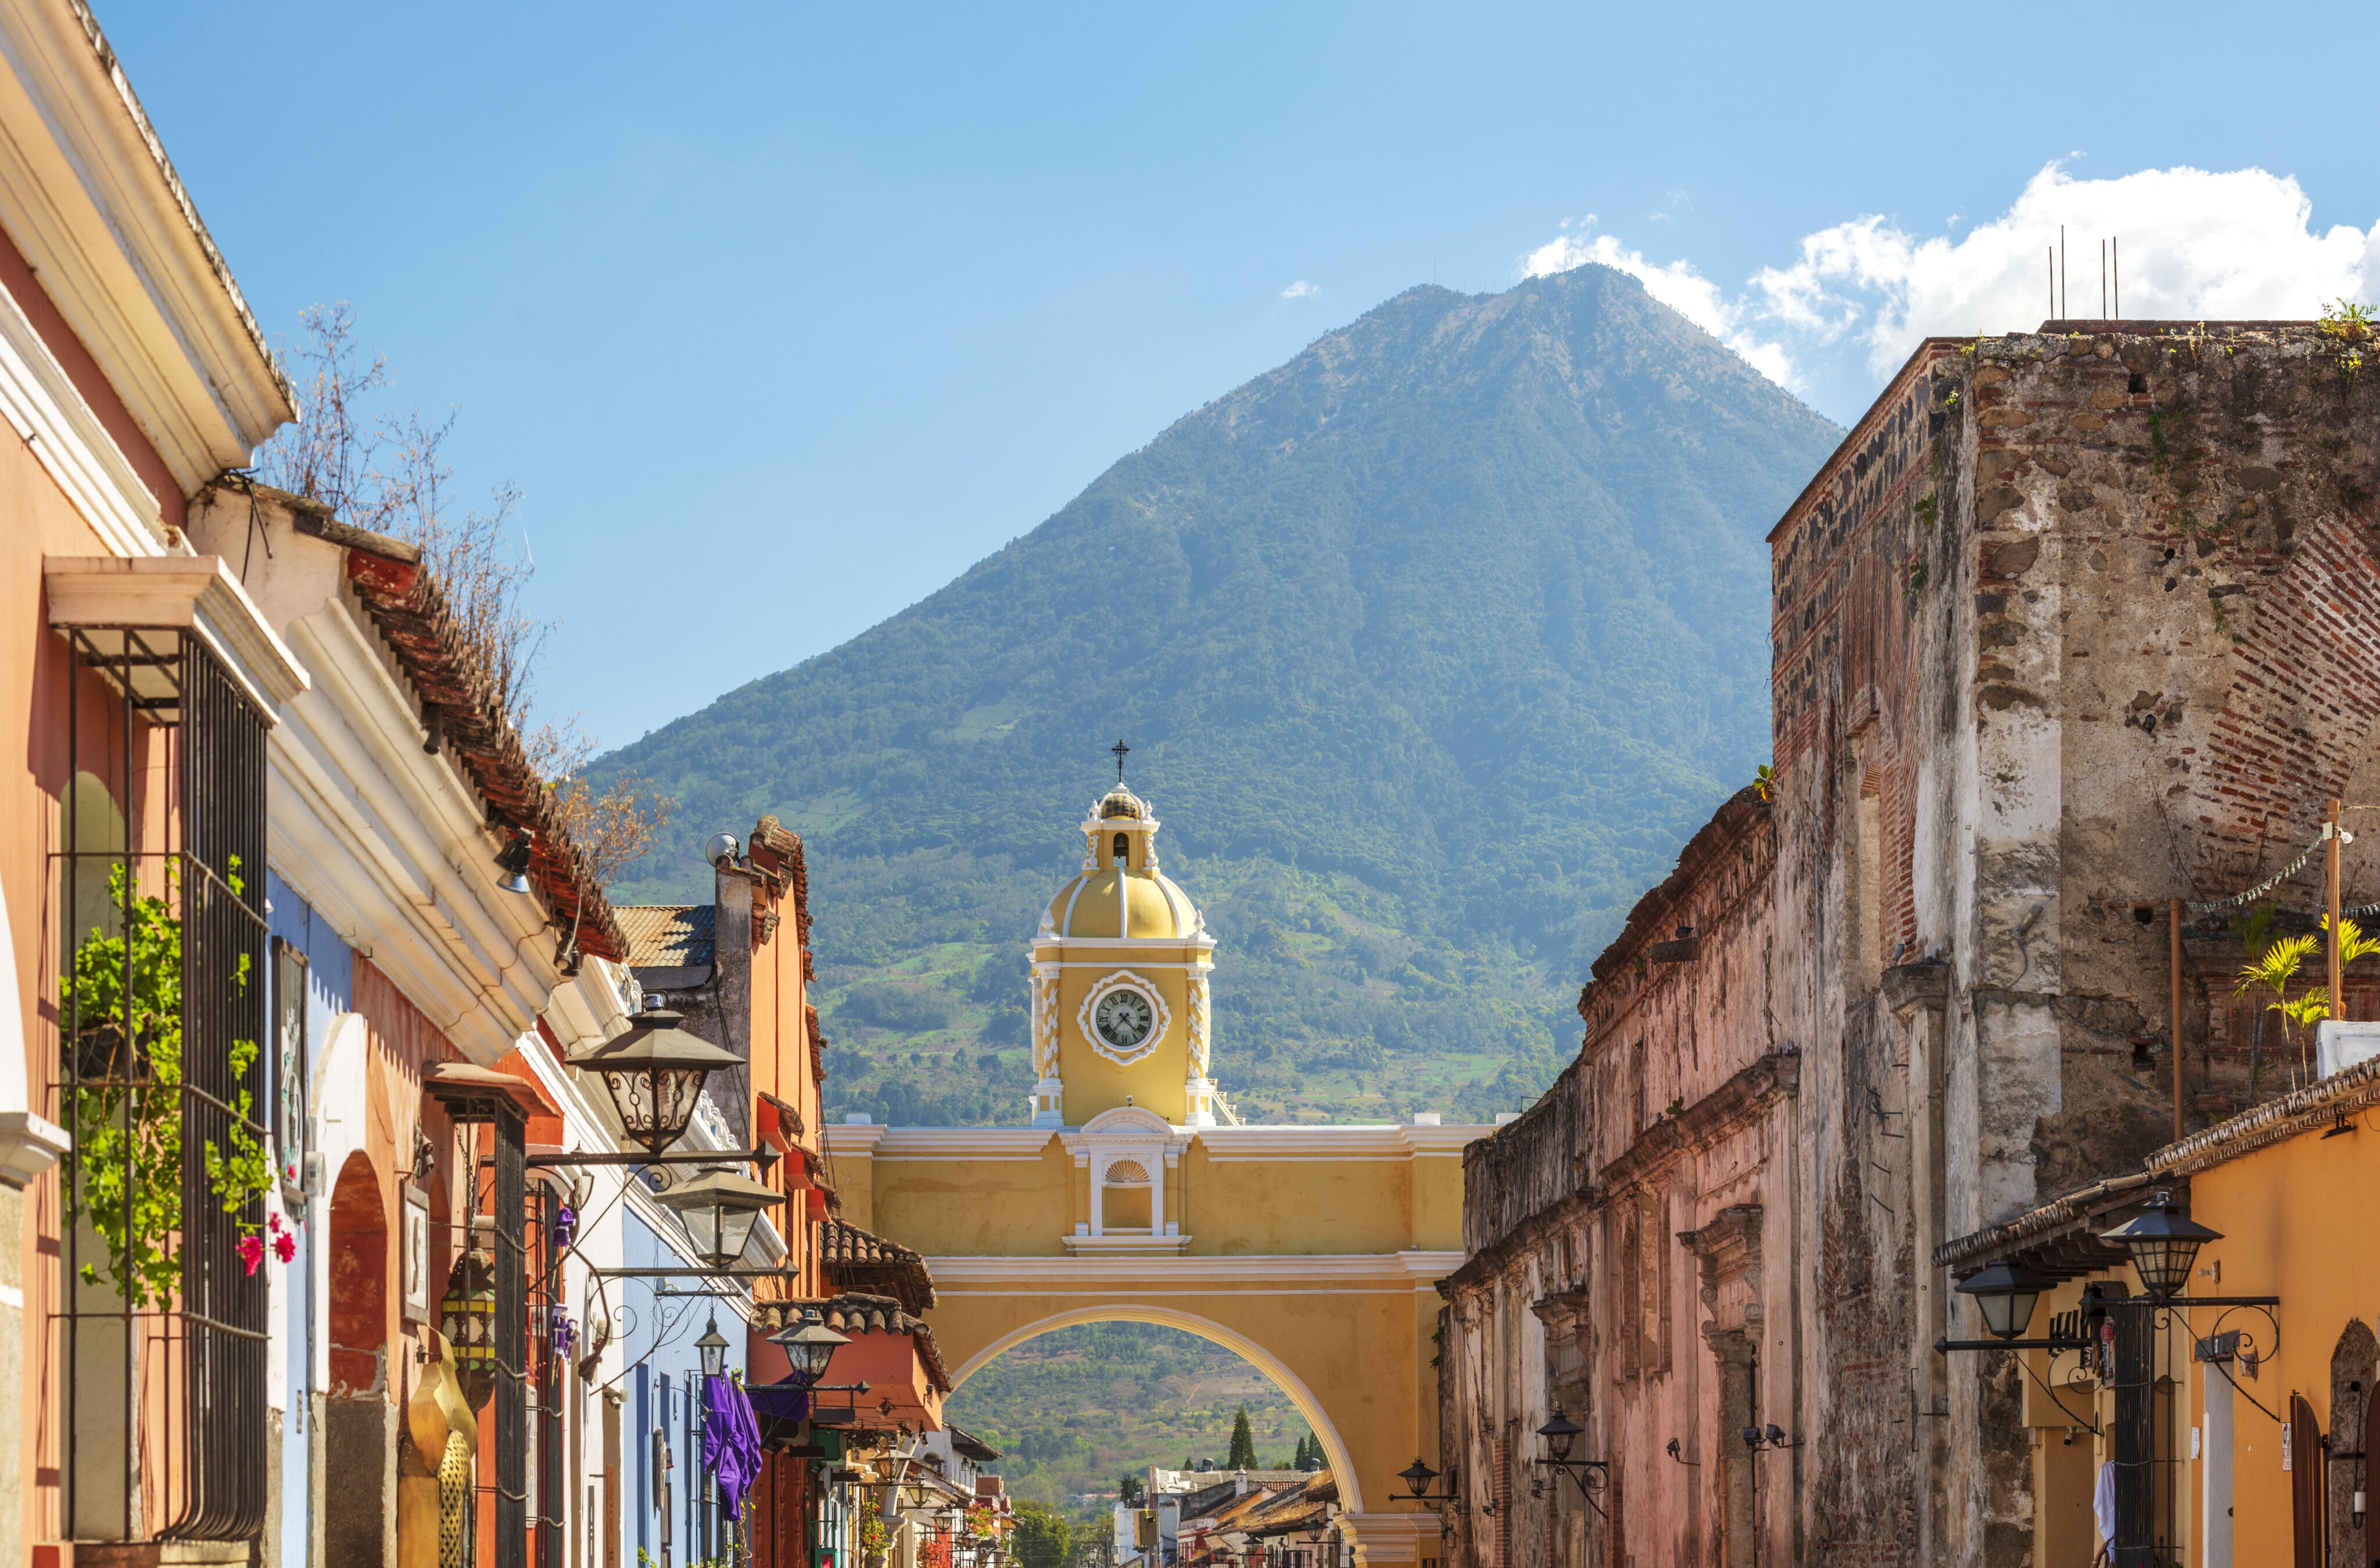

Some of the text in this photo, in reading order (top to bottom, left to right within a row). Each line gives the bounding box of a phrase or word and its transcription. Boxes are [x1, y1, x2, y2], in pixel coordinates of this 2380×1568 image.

[1109, 996, 1119, 1007] XI
[1120, 994, 1128, 1003] XII
[1130, 996, 1137, 1006] I
[1101, 1004, 1111, 1013] X
